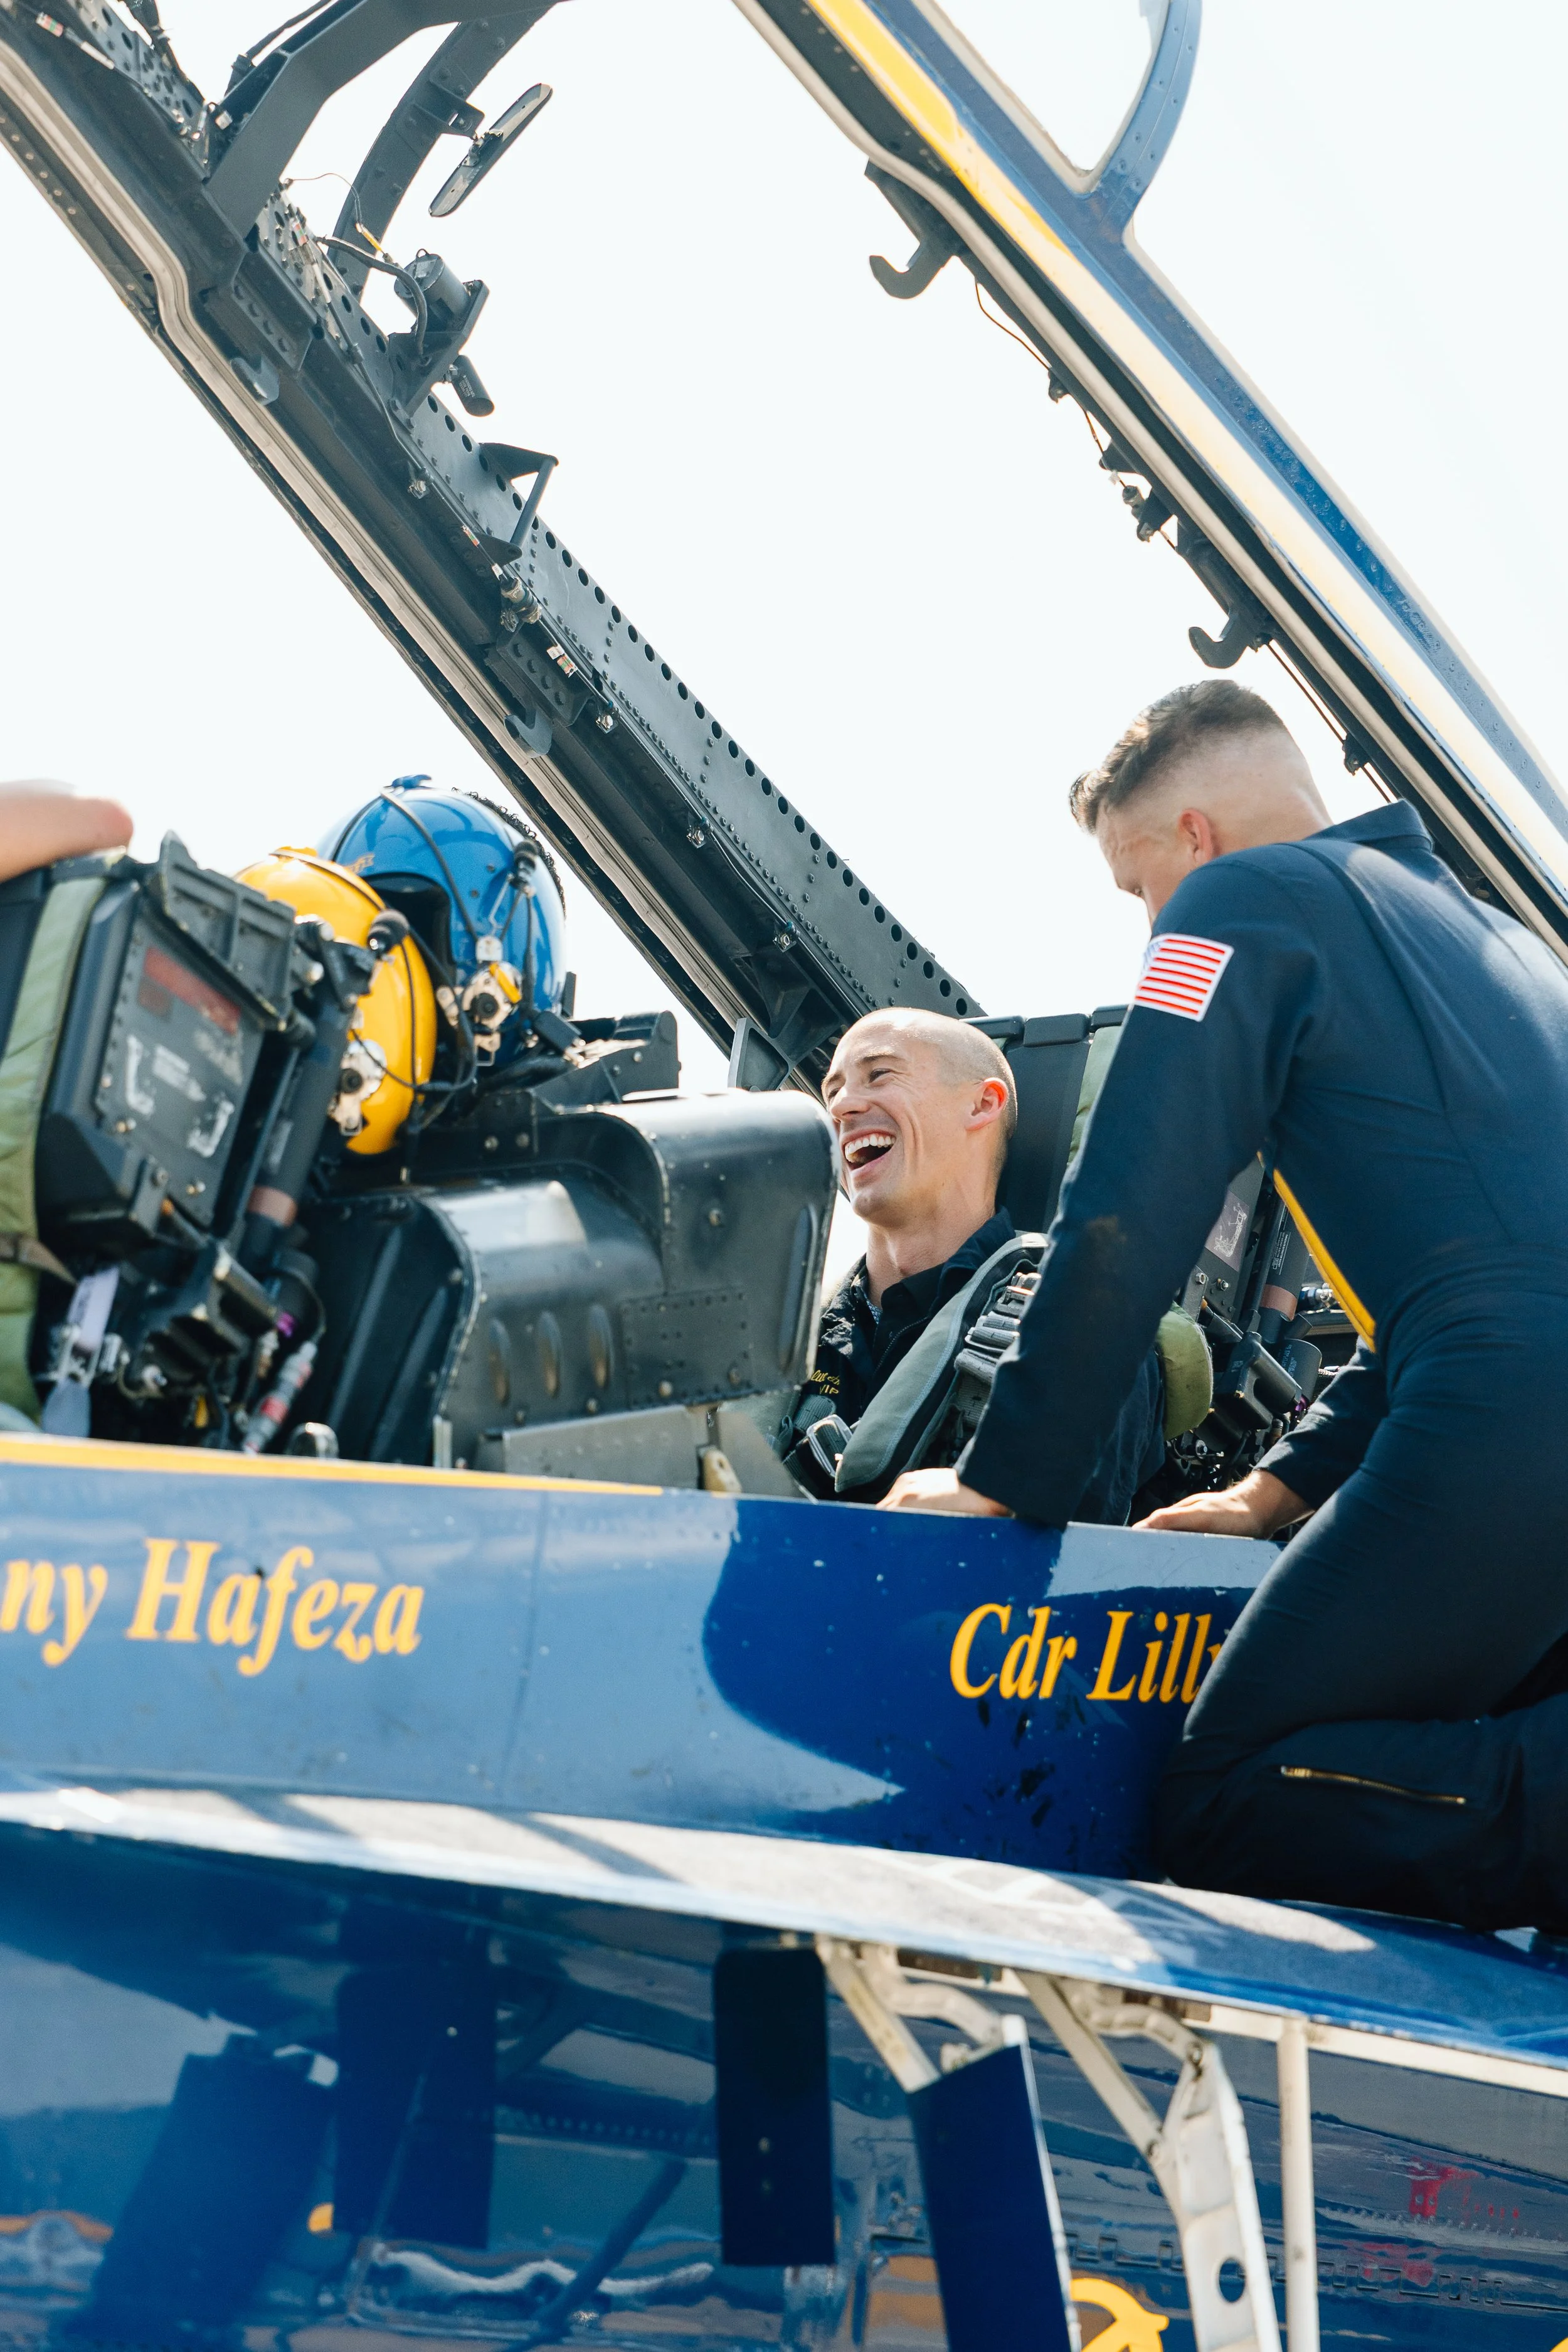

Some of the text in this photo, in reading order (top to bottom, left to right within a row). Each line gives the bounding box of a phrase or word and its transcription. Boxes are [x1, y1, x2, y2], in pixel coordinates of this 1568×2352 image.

[819, 1385, 839, 1395] VIP
[127, 1538, 424, 1676] Hafeza
[950, 1603, 1222, 1704] Cdr Lill
